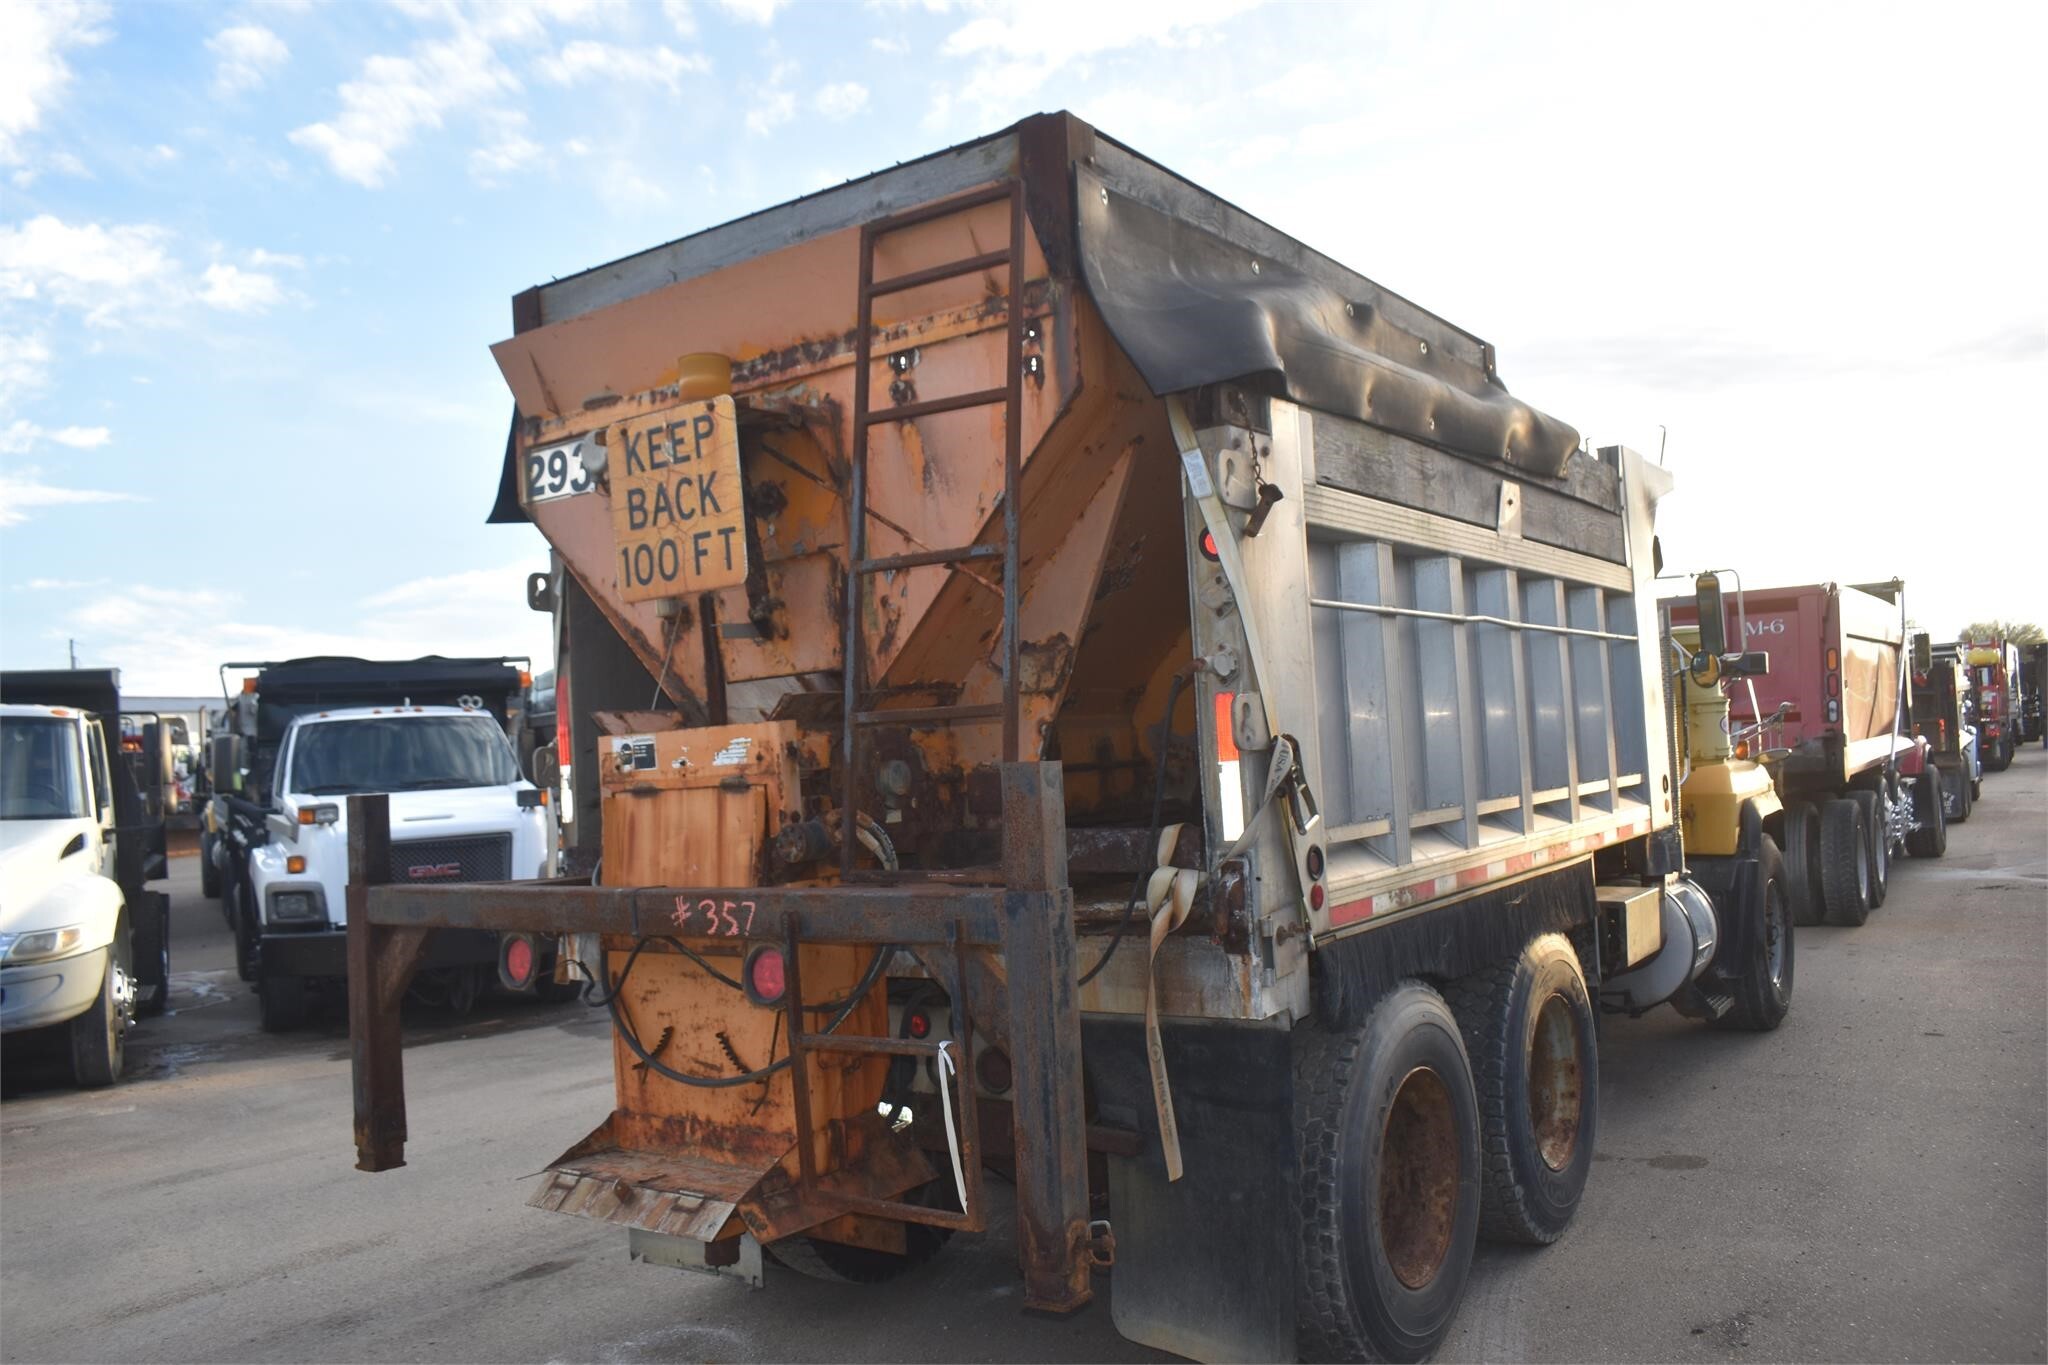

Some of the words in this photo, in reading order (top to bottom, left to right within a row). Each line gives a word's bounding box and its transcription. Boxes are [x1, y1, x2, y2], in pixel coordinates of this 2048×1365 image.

[624, 414, 715, 476] KEEP
[627, 471, 722, 531] BACK
[621, 538, 679, 588] 100
[693, 526, 737, 576] FT
[1745, 618, 1785, 636] M-6
[408, 862, 460, 878] GMC
